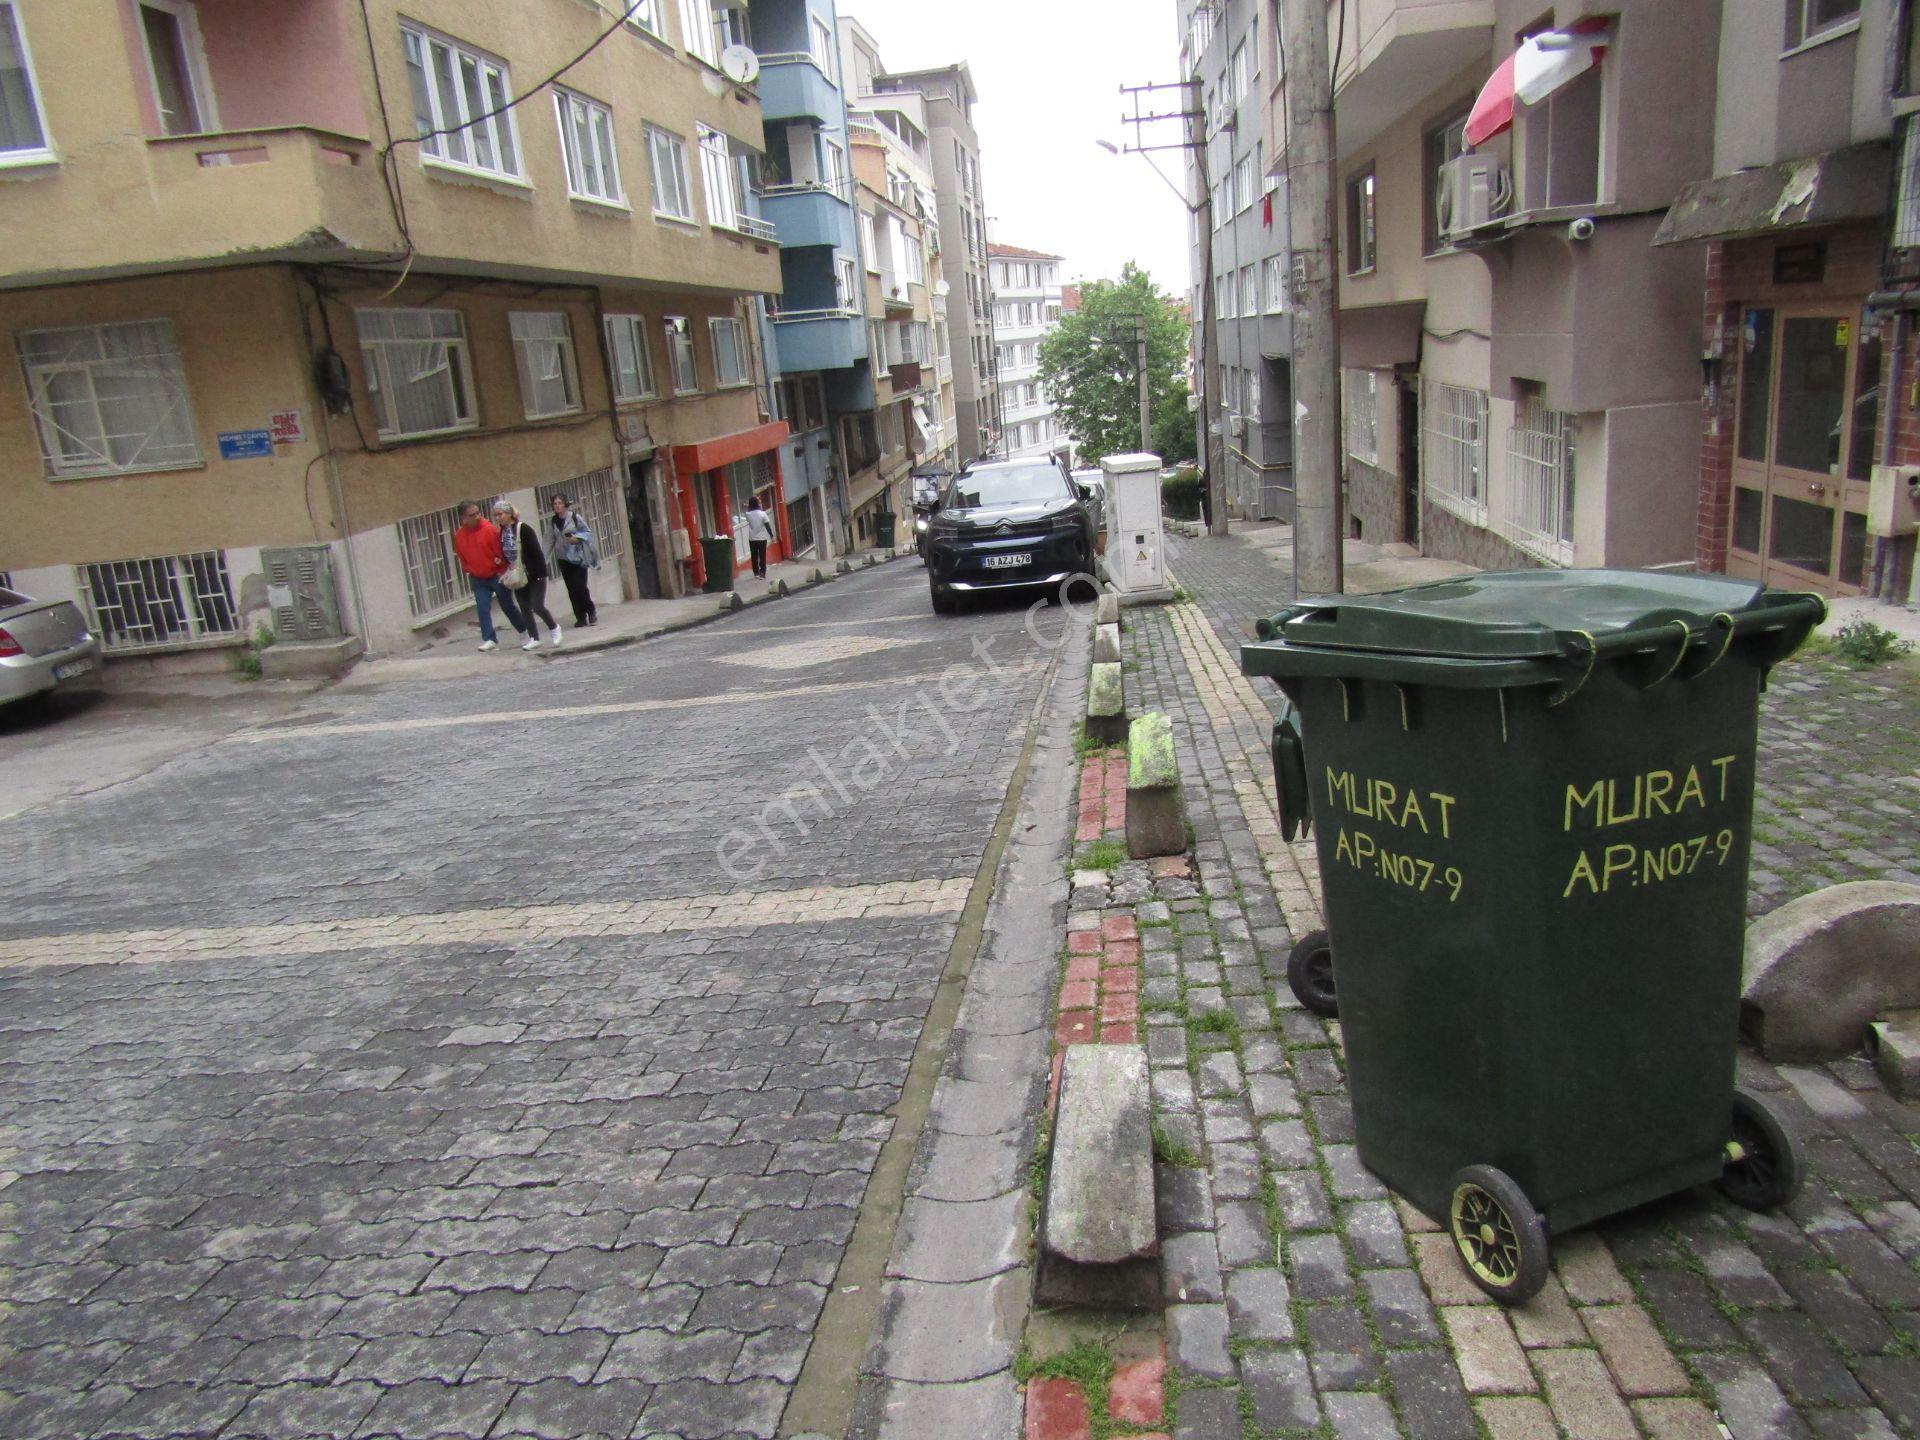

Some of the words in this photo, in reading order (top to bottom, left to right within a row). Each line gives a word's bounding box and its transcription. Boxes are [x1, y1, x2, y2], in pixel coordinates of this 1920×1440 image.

[987, 558, 995, 566] 16
[998, 556, 1013, 565] AZJ
[1016, 554, 1031, 564] 478
[1326, 765, 1456, 839] MURAT
[1563, 754, 1736, 831] MURAT
